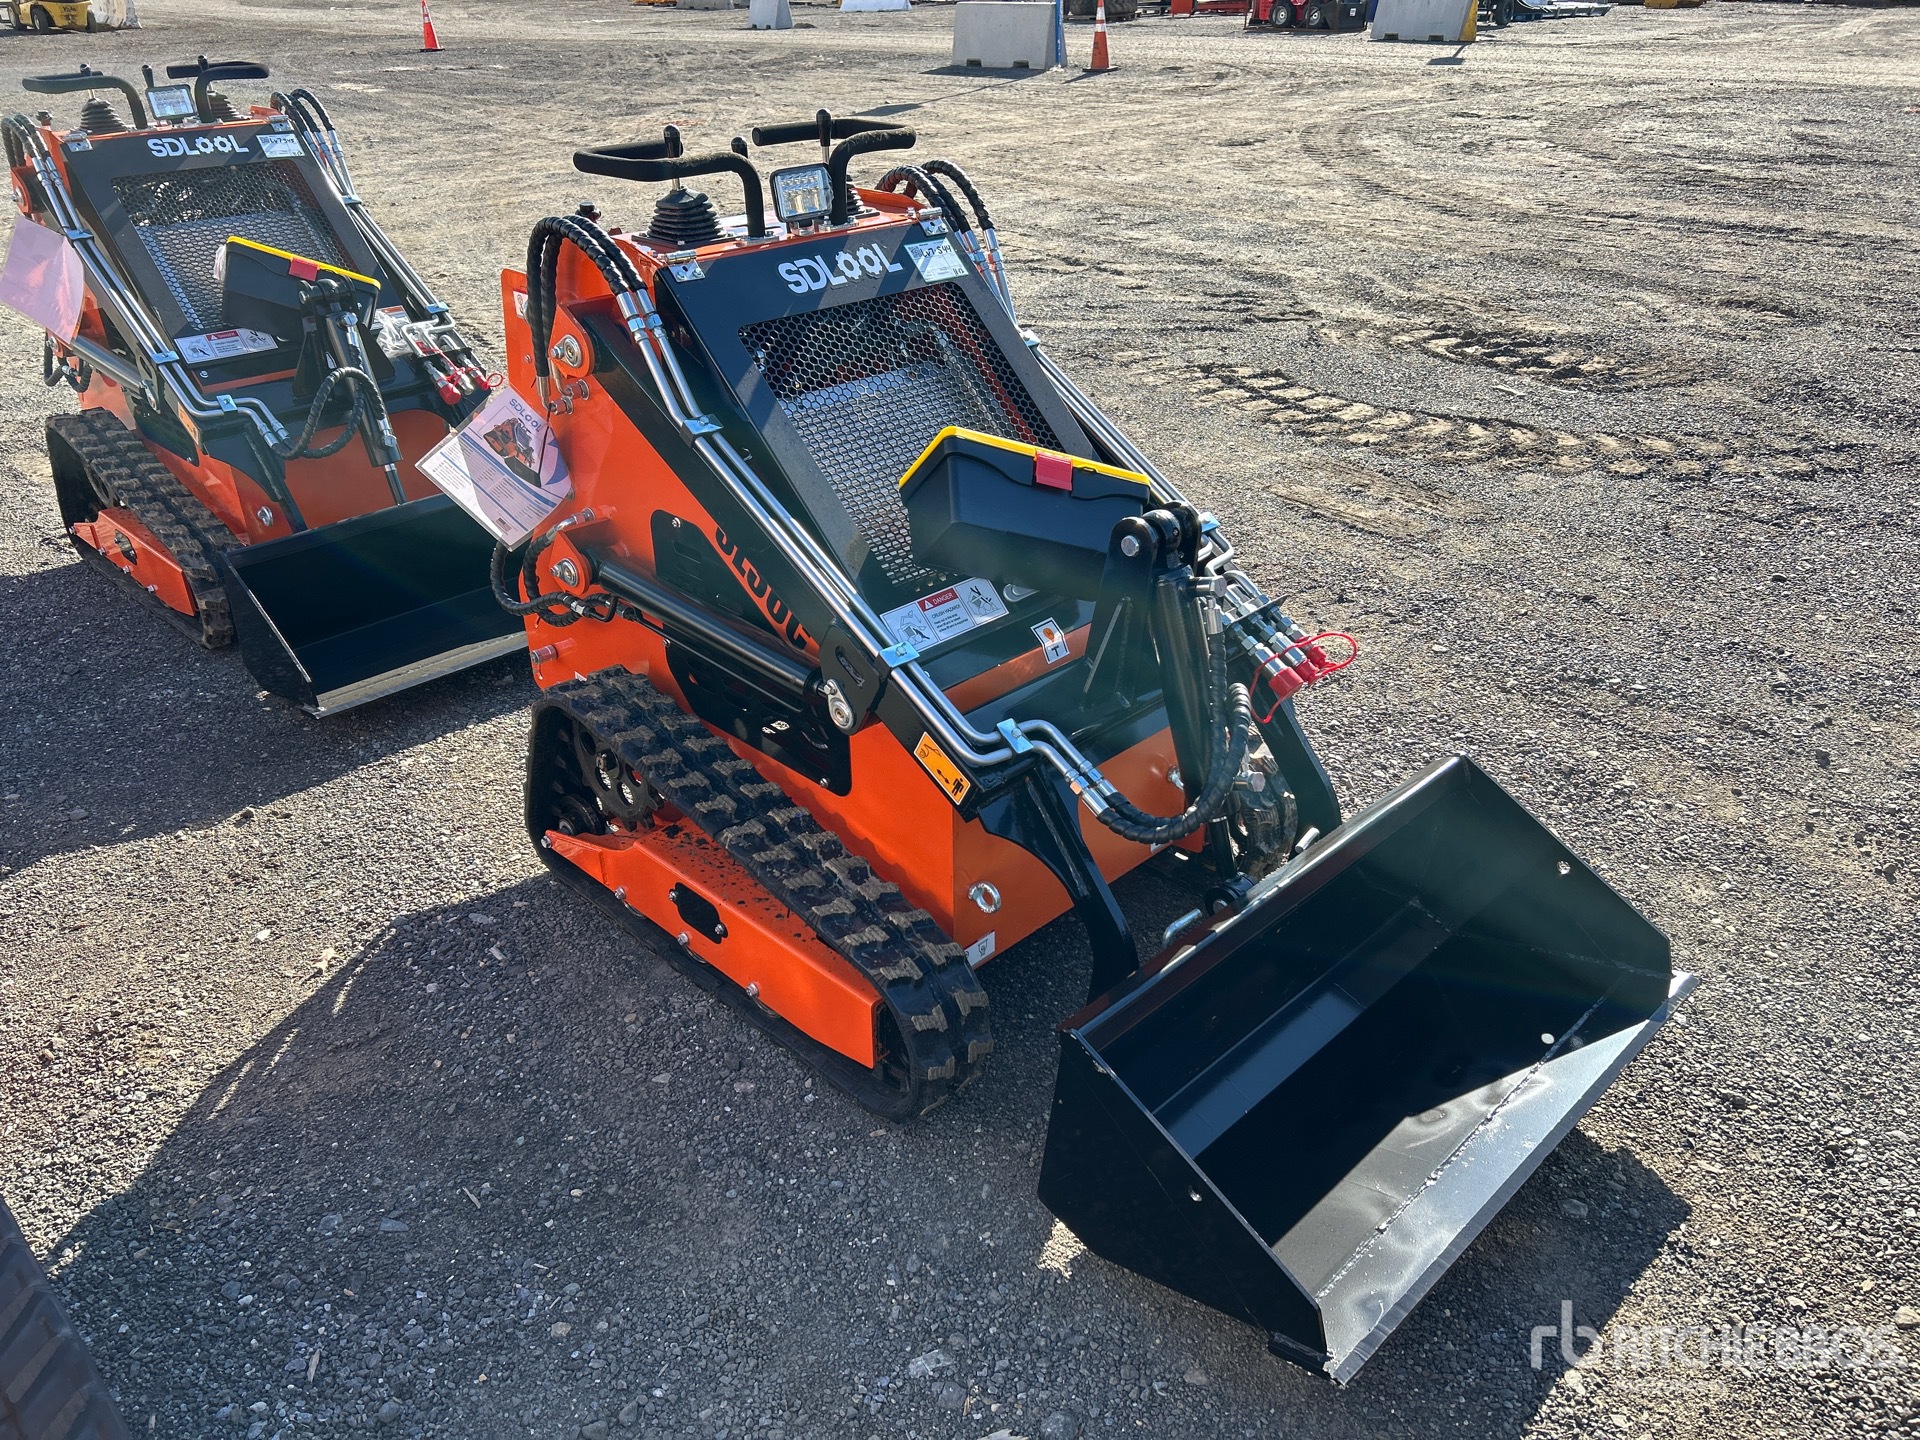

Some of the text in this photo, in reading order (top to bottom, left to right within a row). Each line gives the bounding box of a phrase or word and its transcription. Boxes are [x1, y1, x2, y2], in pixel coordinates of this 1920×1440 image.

[147, 134, 250, 158] SDLOOL
[777, 243, 903, 294] SDLOOL
[509, 398, 542, 432] SDLOOL
[932, 592, 954, 605] DANGER
